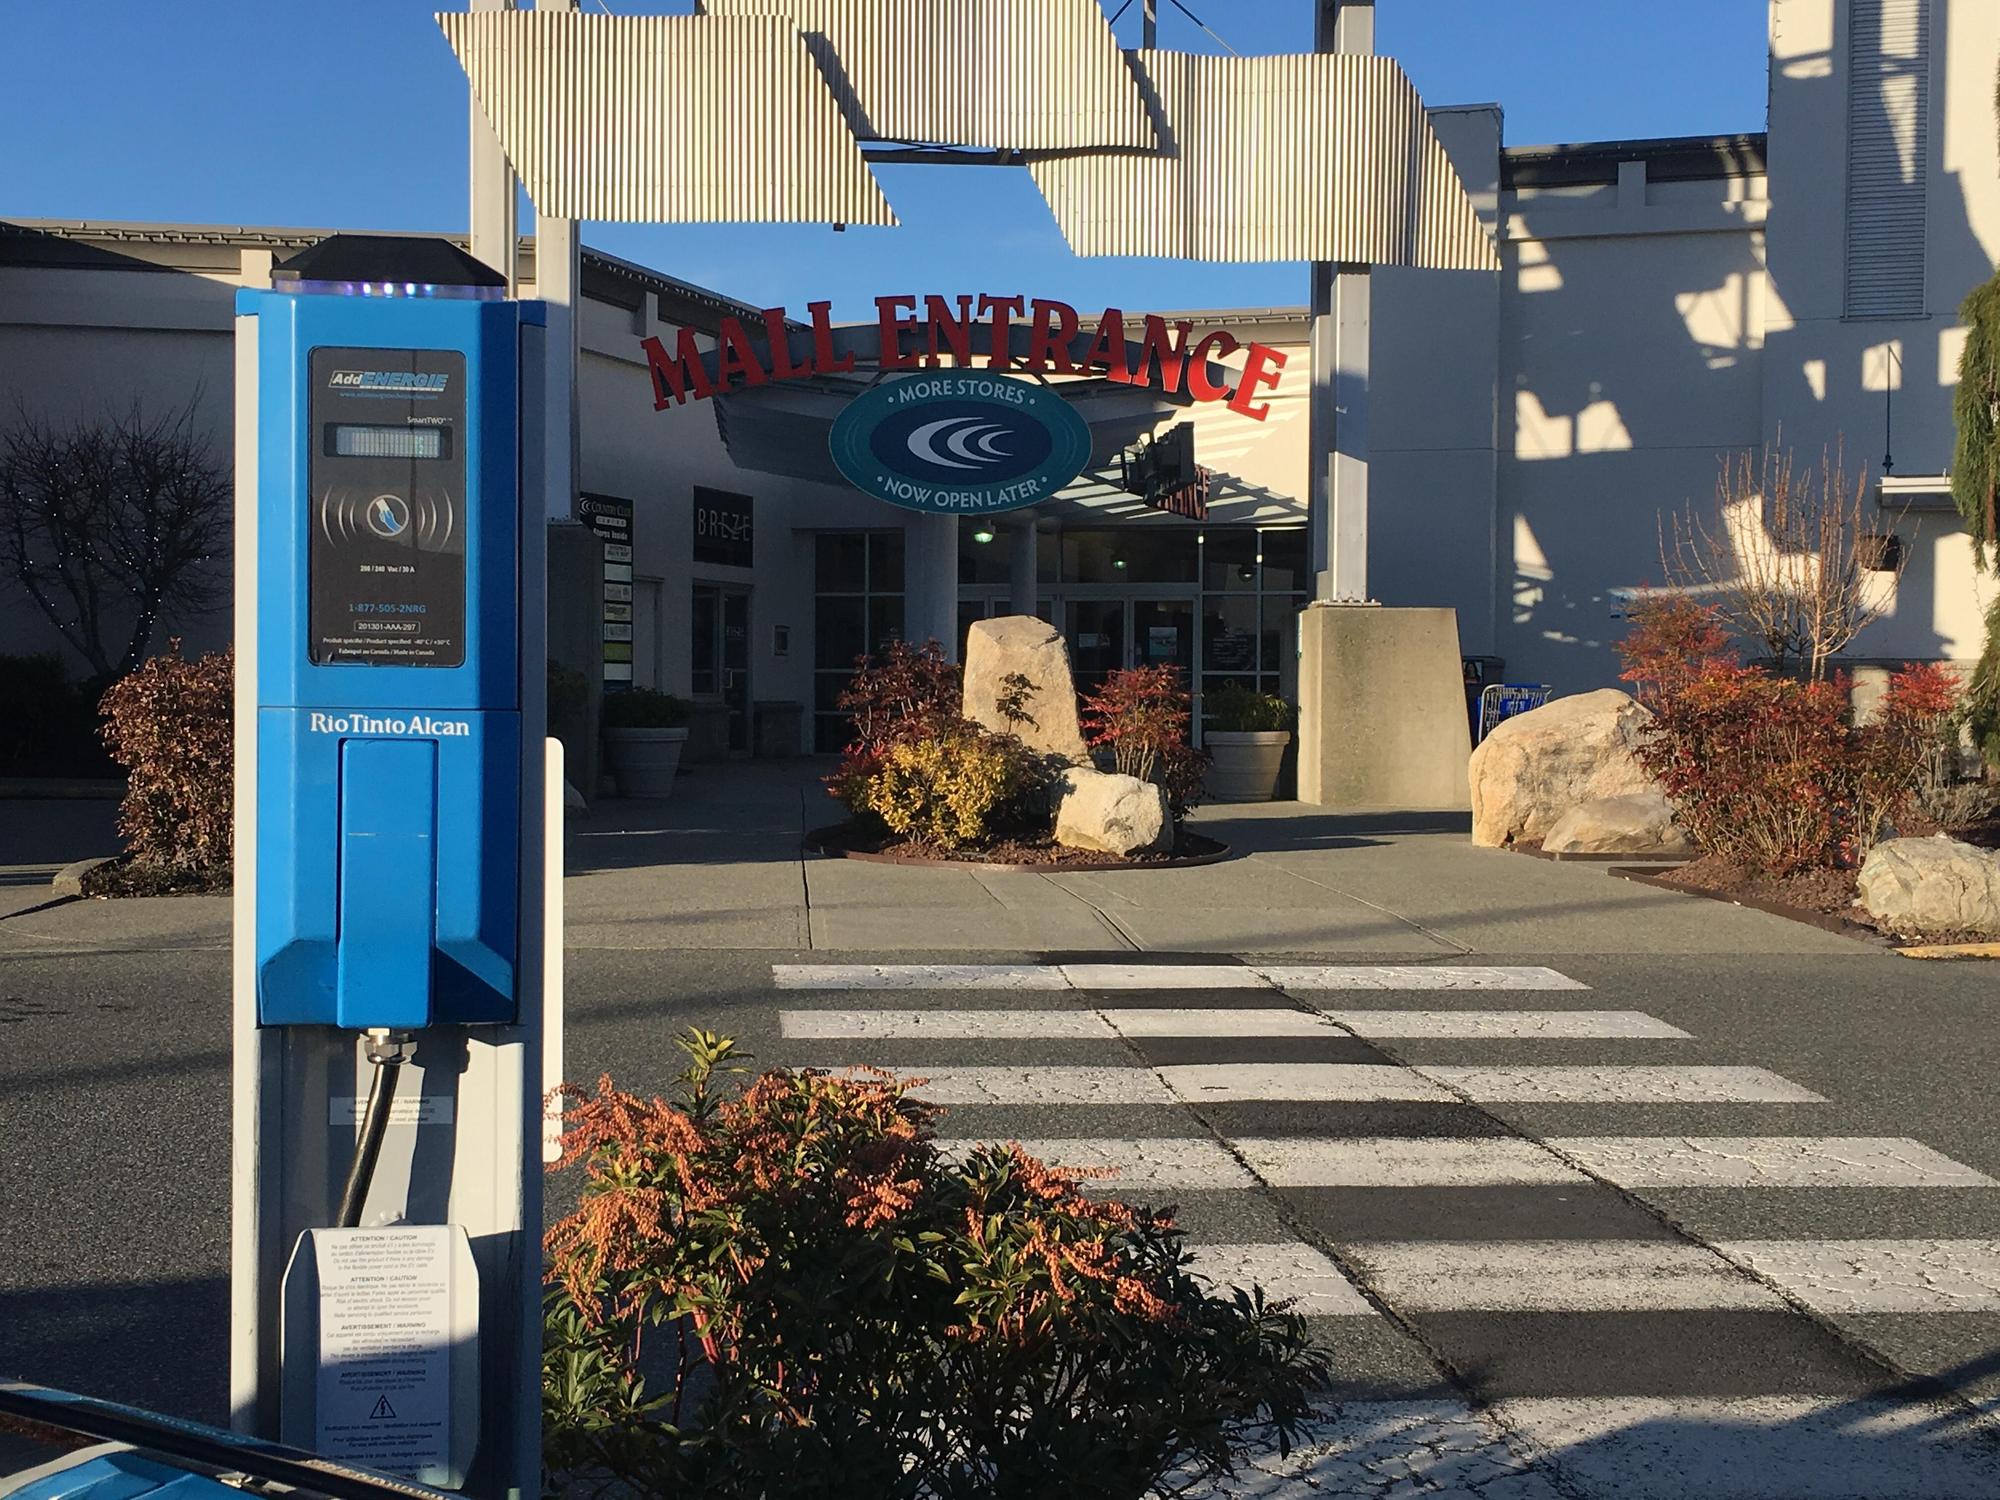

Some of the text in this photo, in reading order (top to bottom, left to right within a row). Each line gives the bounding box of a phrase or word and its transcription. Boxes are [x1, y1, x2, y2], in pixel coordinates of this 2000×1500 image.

[639, 294, 1289, 421] MALL ENTRANCE
[898, 379, 1026, 405] MORE STORES
[884, 477, 1041, 507] NOW OPEN LATER
[698, 507, 751, 542] BREZE
[349, 603, 426, 614] 1-877-505-2NRG
[310, 712, 470, 737] Rio Tinto Alcan
[350, 1275, 385, 1283] ATTENTION
